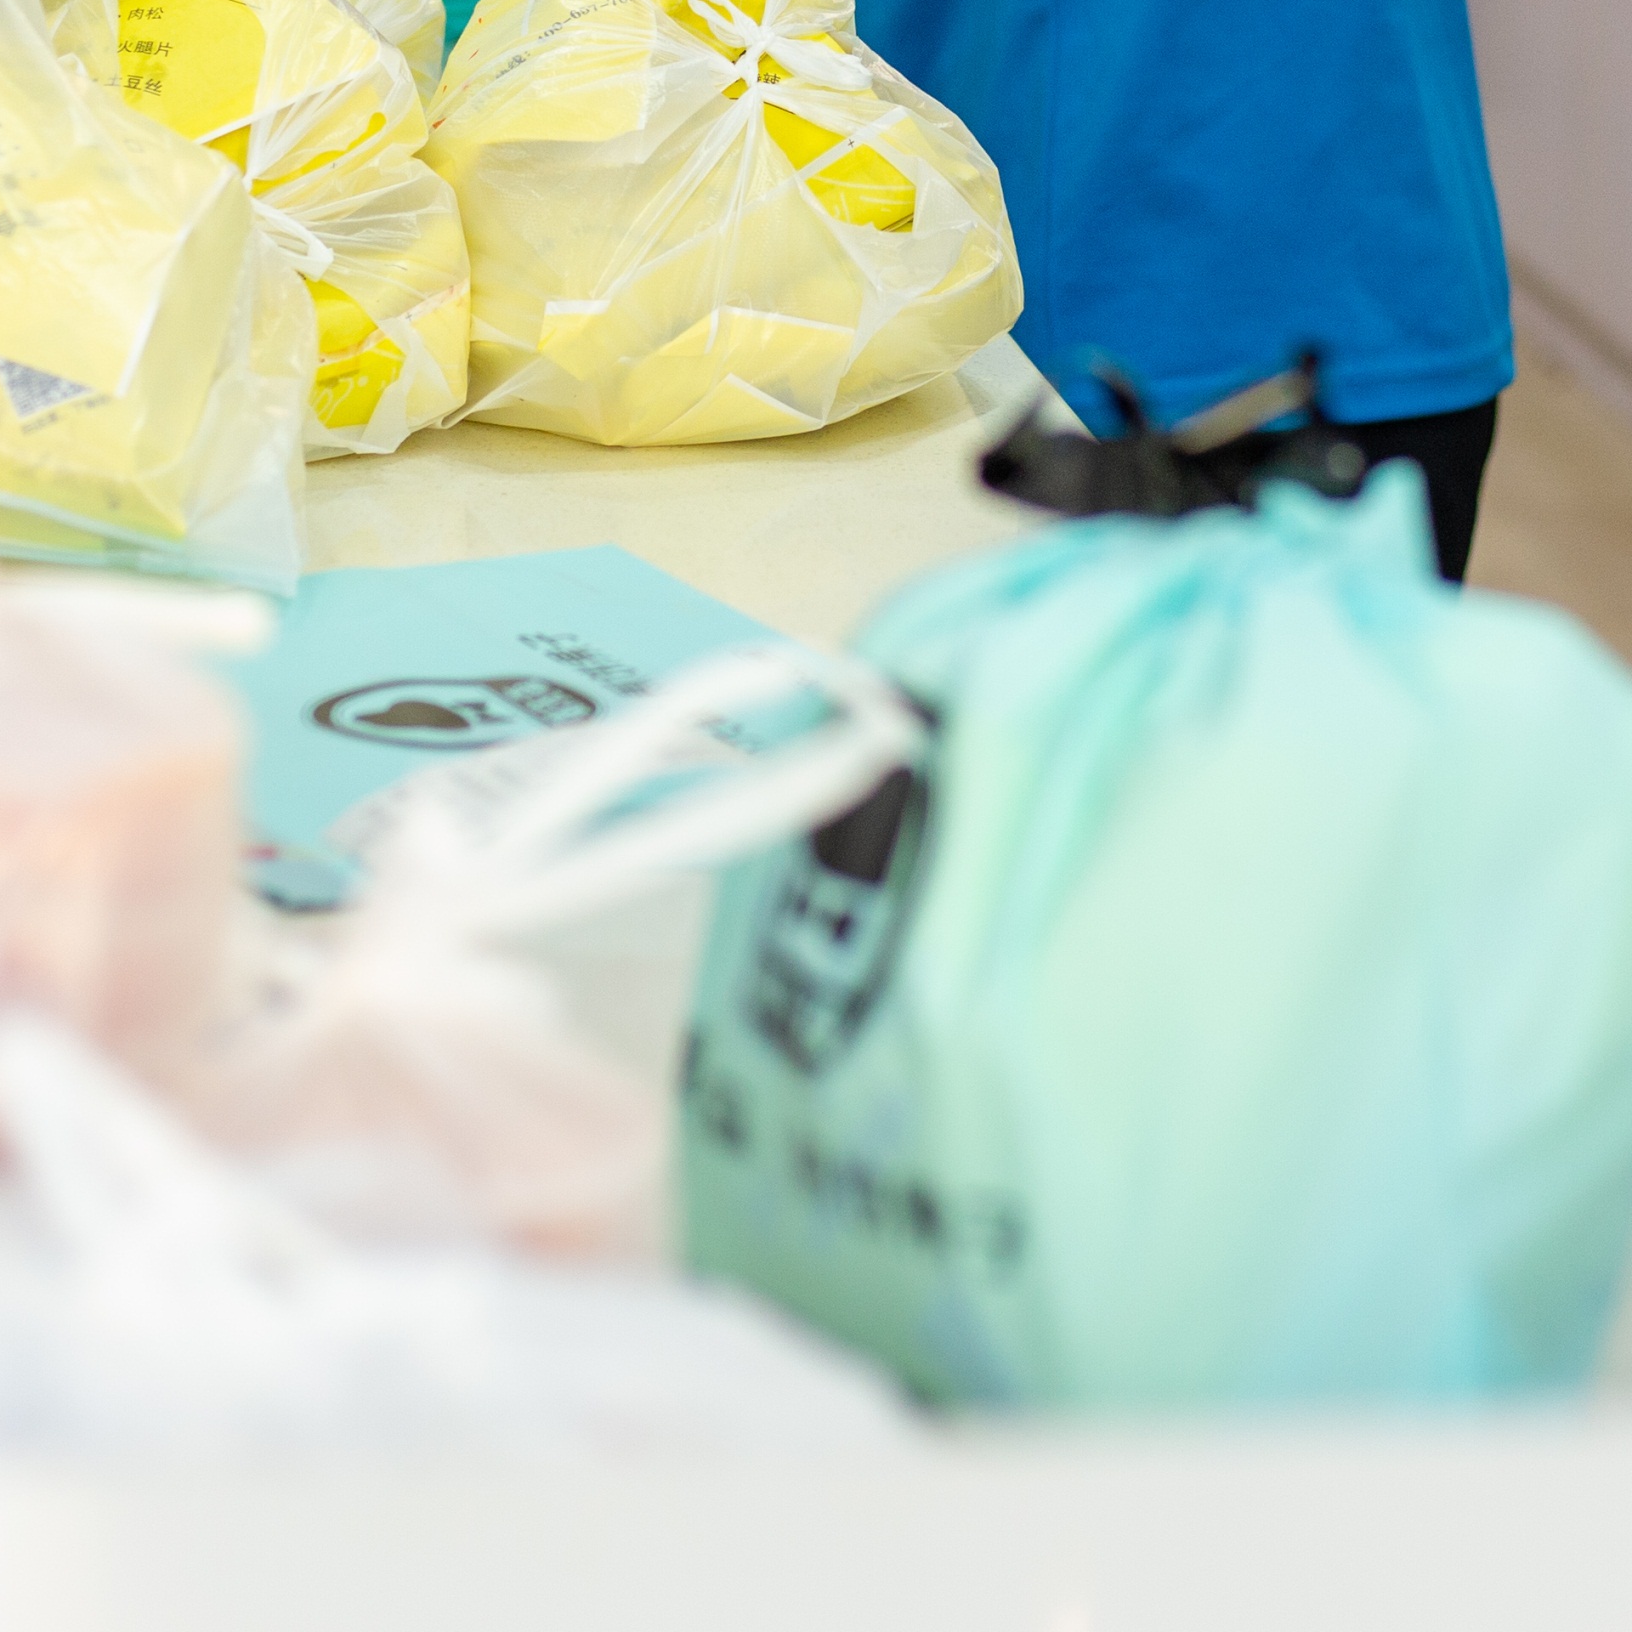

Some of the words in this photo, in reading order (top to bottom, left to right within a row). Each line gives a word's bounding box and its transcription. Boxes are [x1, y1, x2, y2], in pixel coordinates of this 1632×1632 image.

[127, 7, 165, 21] 肉松
[117, 40, 174, 57] 火腿片
